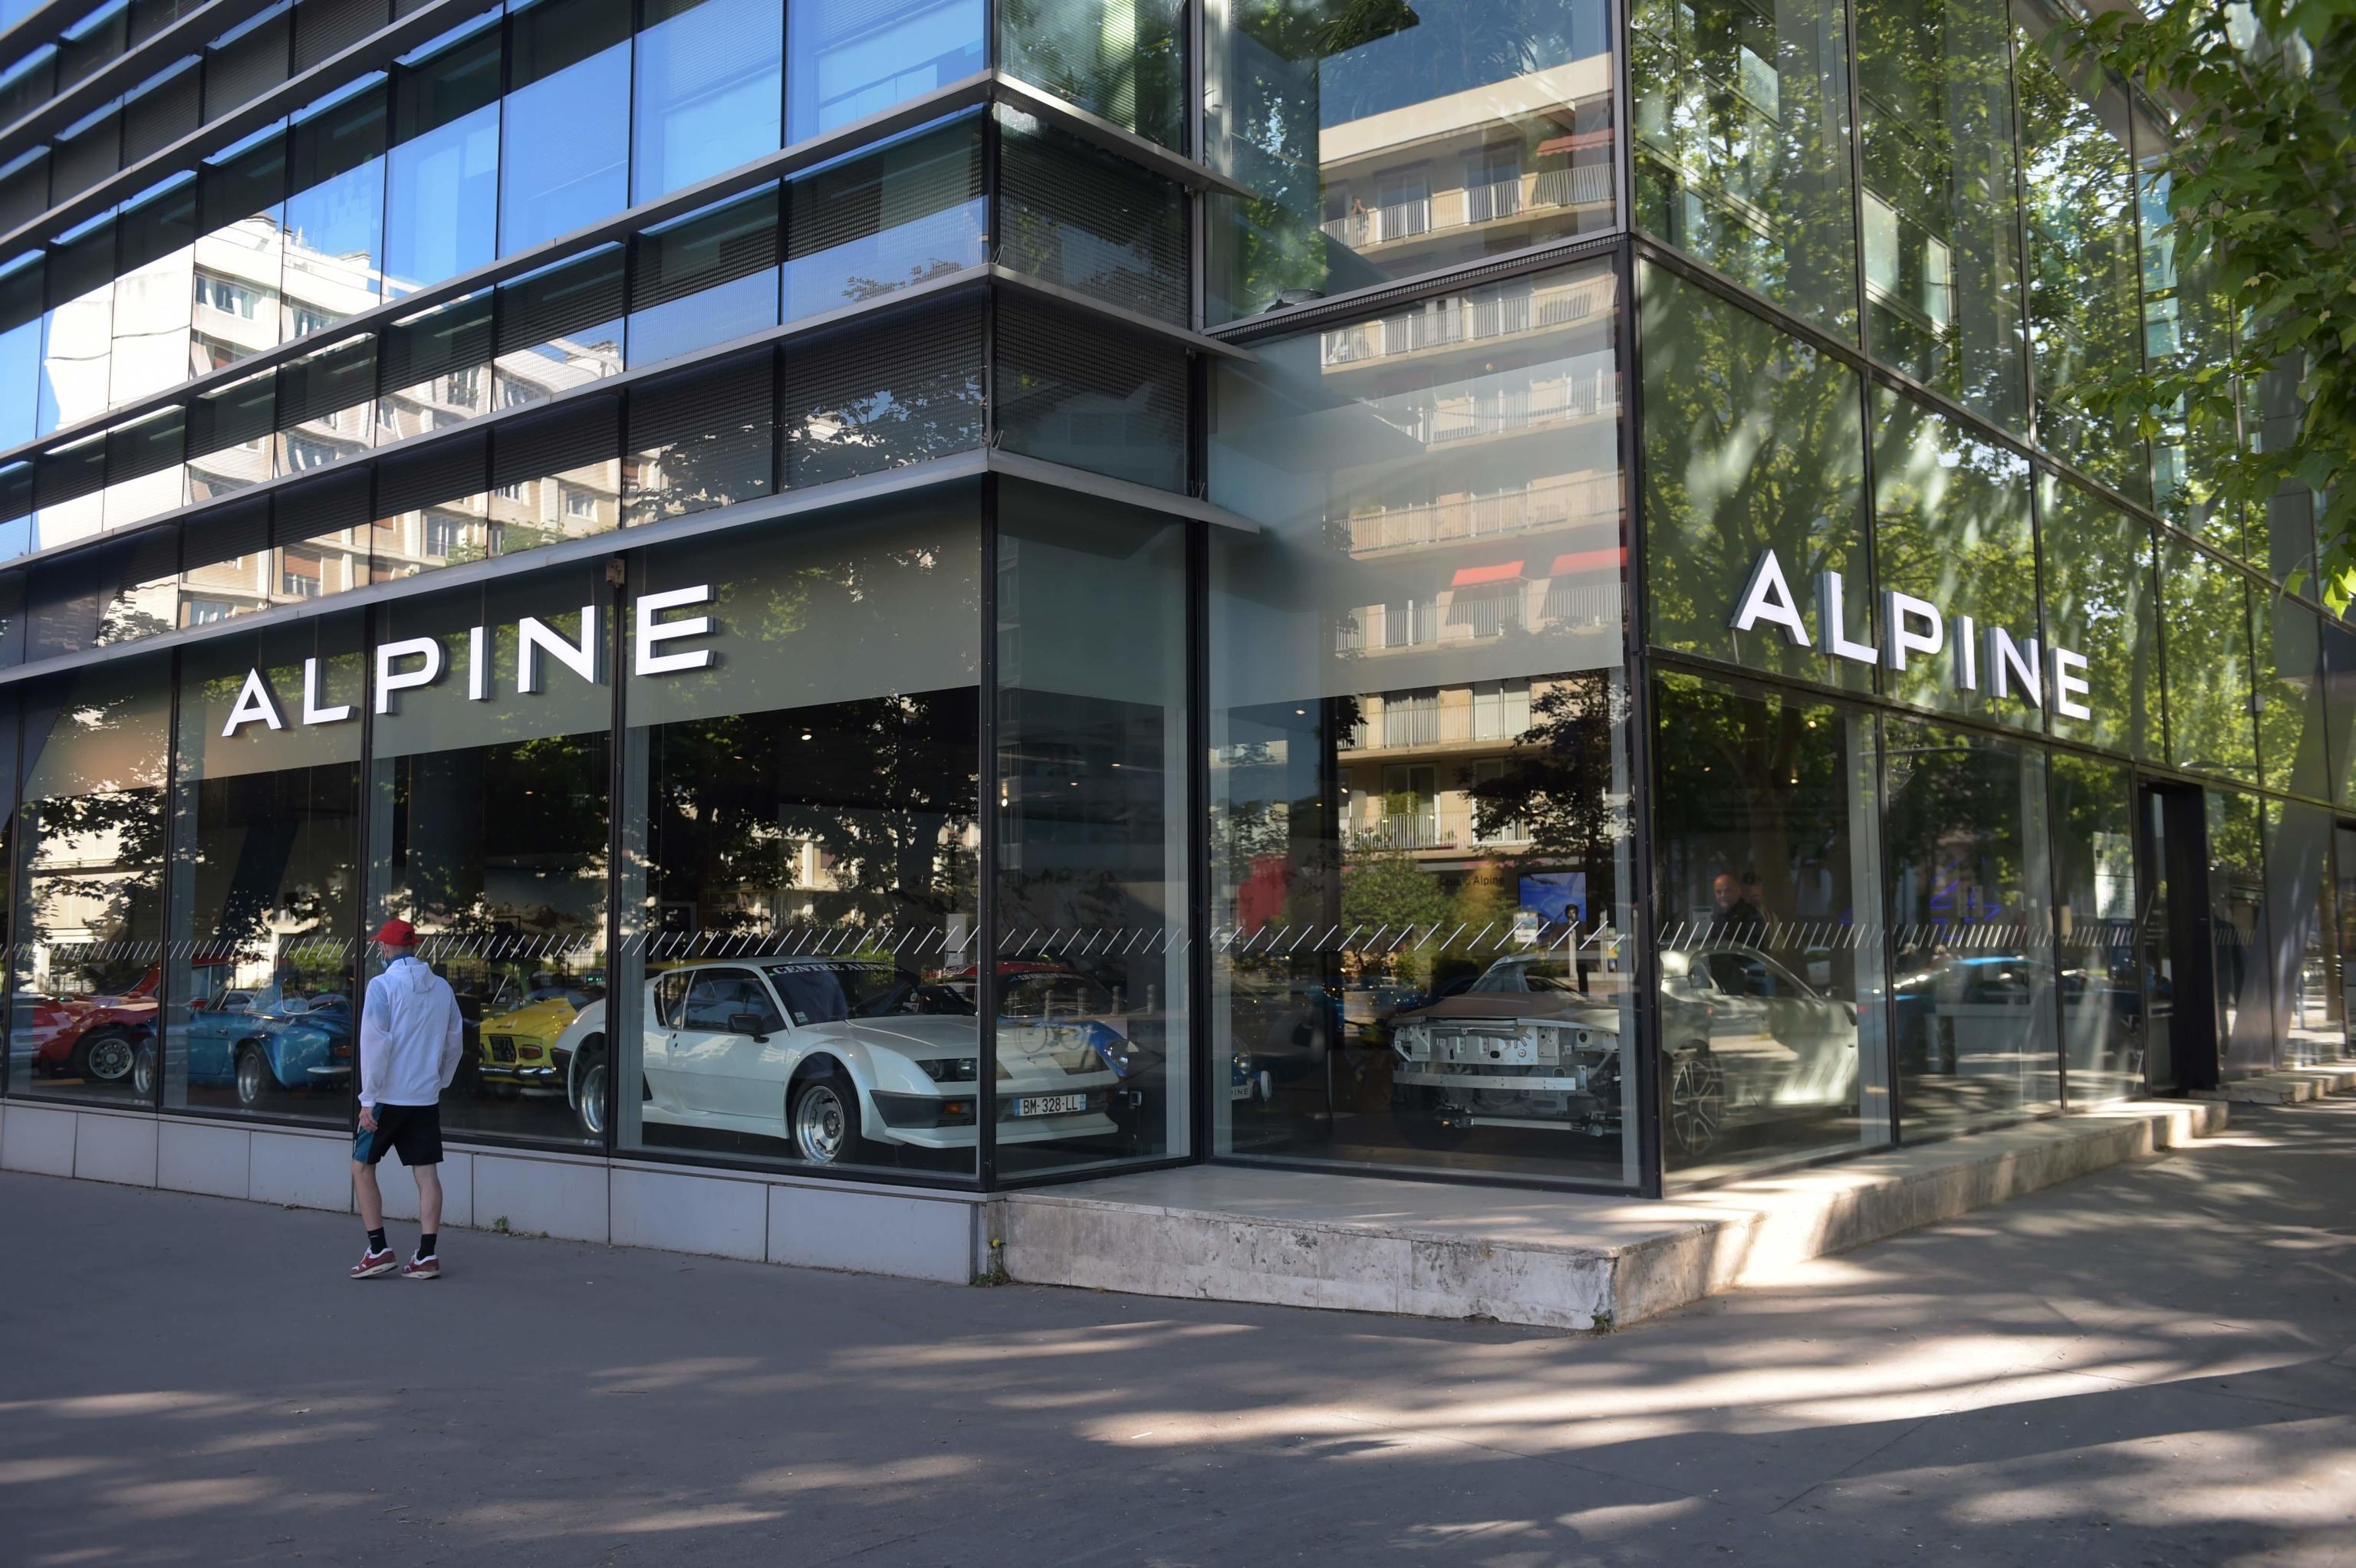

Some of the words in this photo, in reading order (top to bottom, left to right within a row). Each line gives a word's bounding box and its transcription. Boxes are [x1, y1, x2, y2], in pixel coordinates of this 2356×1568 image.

[221, 585, 715, 738] ALPINE
[1729, 549, 2091, 721] ALPINE
[1473, 876, 1505, 886] Alpine
[772, 963, 844, 975] CENTRE
